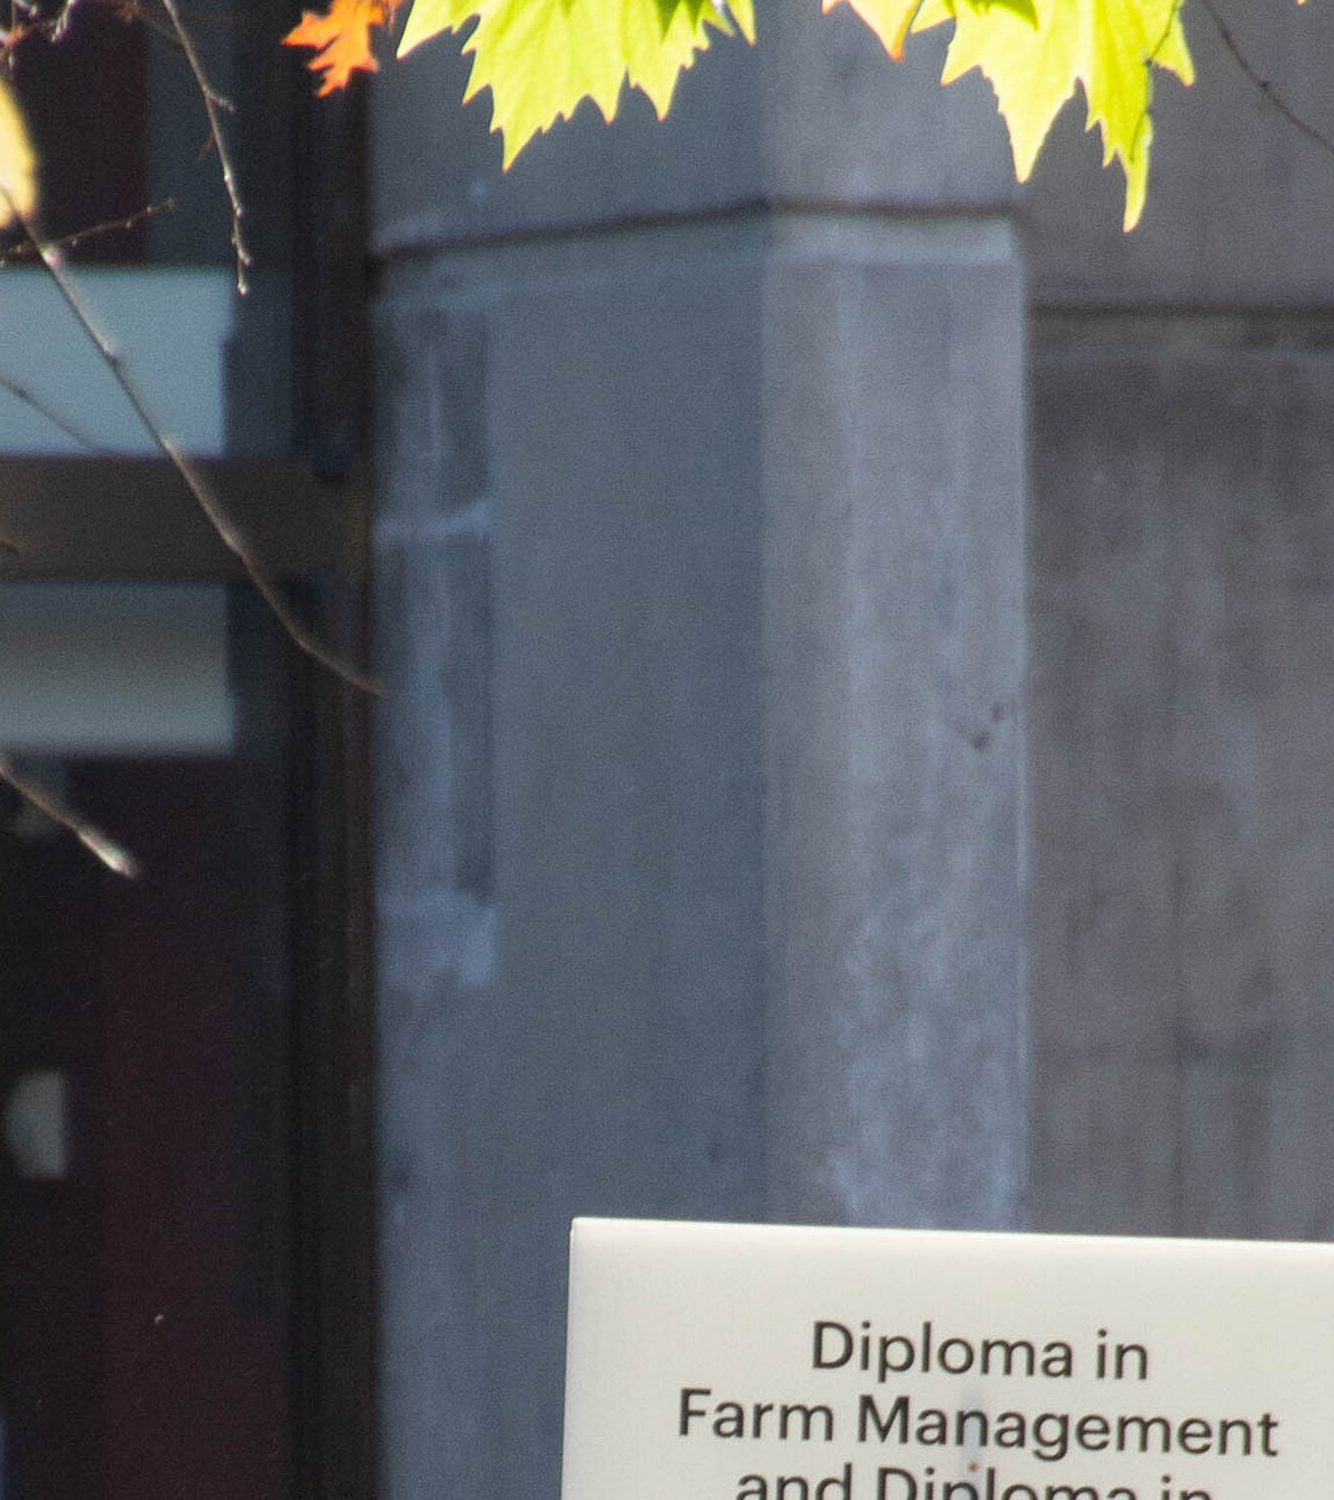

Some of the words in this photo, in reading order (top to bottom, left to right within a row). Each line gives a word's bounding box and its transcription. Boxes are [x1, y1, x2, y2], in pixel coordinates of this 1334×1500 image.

[811, 1320, 1073, 1383] Diploma
[1096, 1328, 1149, 1381] in
[678, 1386, 834, 1442] Farm
[857, 1393, 1279, 1462] Management
